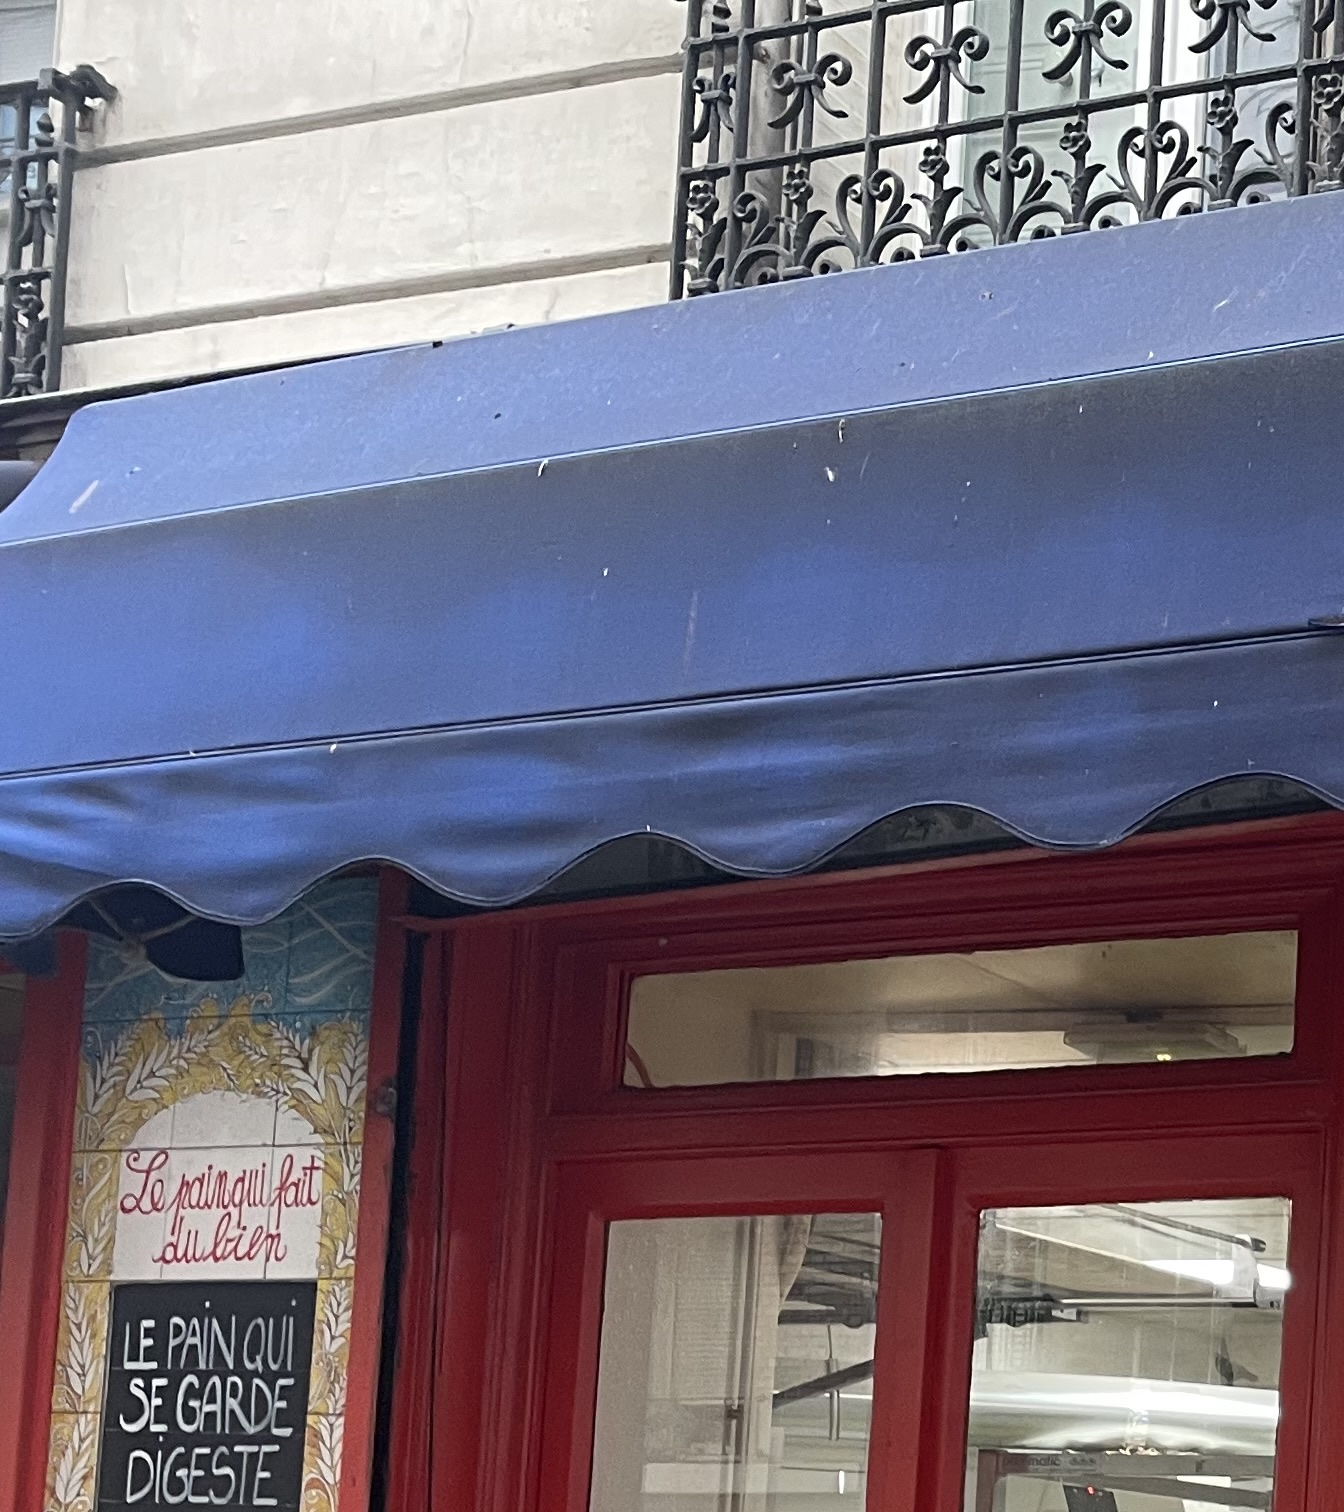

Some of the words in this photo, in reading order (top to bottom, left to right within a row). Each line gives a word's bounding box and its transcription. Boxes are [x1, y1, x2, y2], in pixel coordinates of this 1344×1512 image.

[120, 1150, 169, 1215] Le
[168, 1164, 231, 1236] pain
[231, 1162, 266, 1230] qui
[271, 1153, 323, 1230] fait
[152, 1215, 206, 1264] du
[203, 1211, 287, 1263] bien
[122, 1318, 158, 1372] LE
[168, 1301, 239, 1371] PAIN
[243, 1299, 297, 1373] QUI
[119, 1376, 169, 1433] SE
[175, 1376, 295, 1437] GARDE
[126, 1436, 280, 1506] DIGESTE
